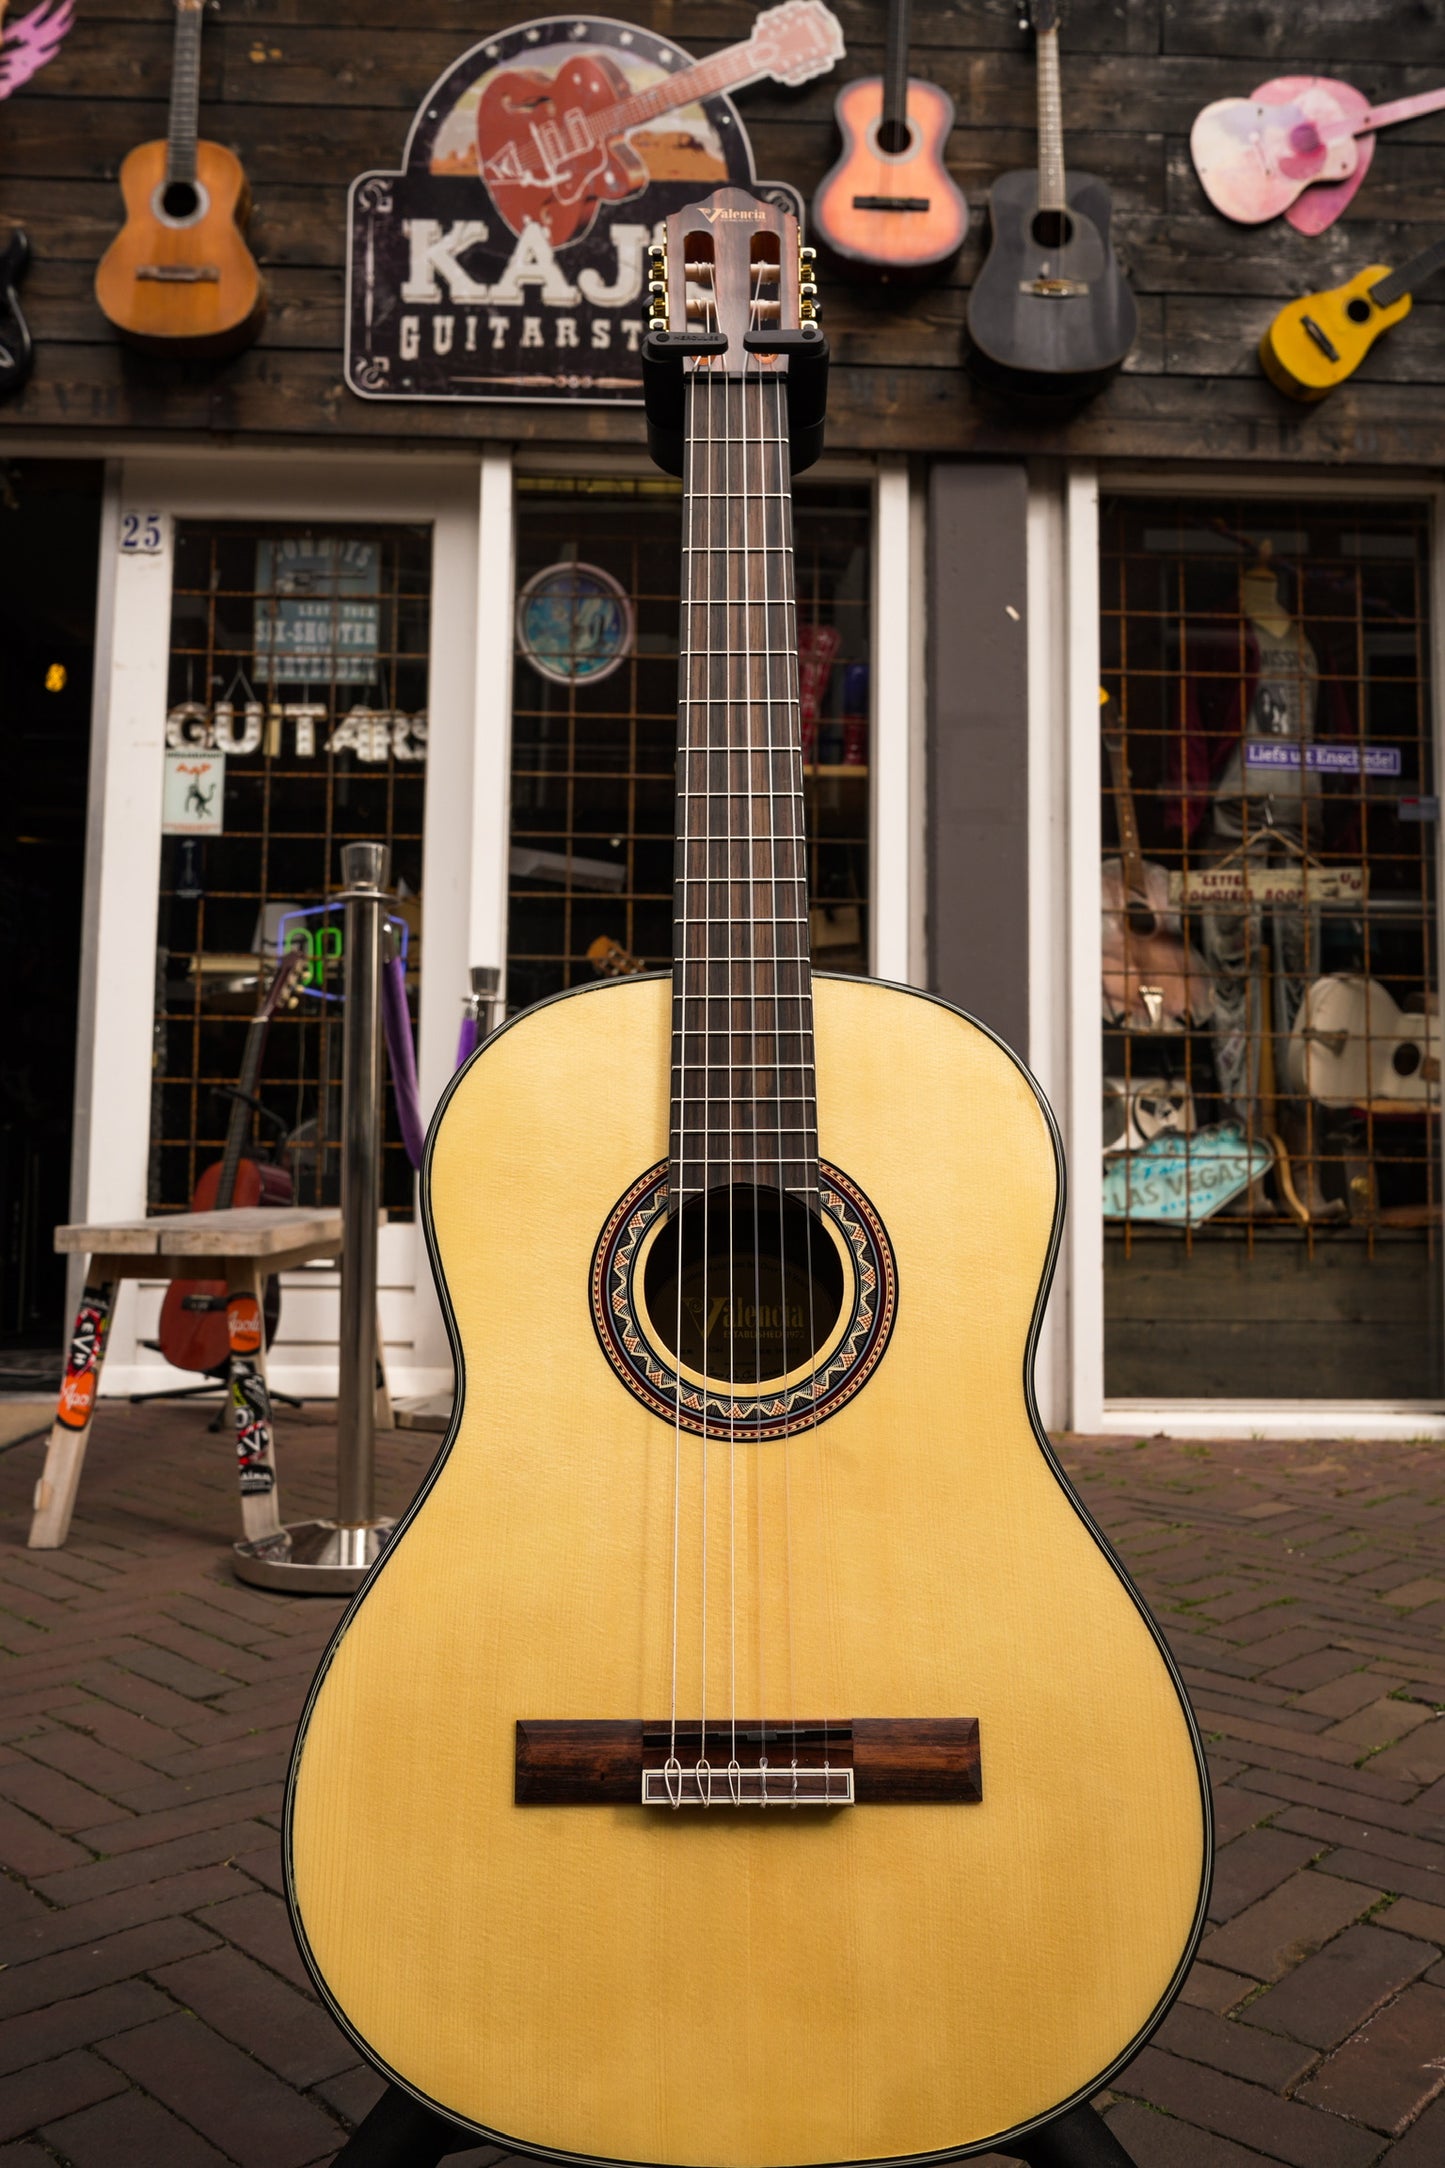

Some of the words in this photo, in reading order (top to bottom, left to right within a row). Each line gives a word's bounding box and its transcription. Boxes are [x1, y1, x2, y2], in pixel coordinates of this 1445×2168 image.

[697, 207, 767, 224] Valencia
[400, 217, 668, 308] KAJ'
[123, 515, 161, 548] 25
[1249, 745, 1289, 764] Liefs
[1290, 749, 1314, 765] ut
[1112, 1181, 1158, 1213] LAS
[1165, 1159, 1247, 1196] VEGAS
[681, 1296, 805, 1339] Valencia
[723, 1330, 783, 1339] ETABLSHED
